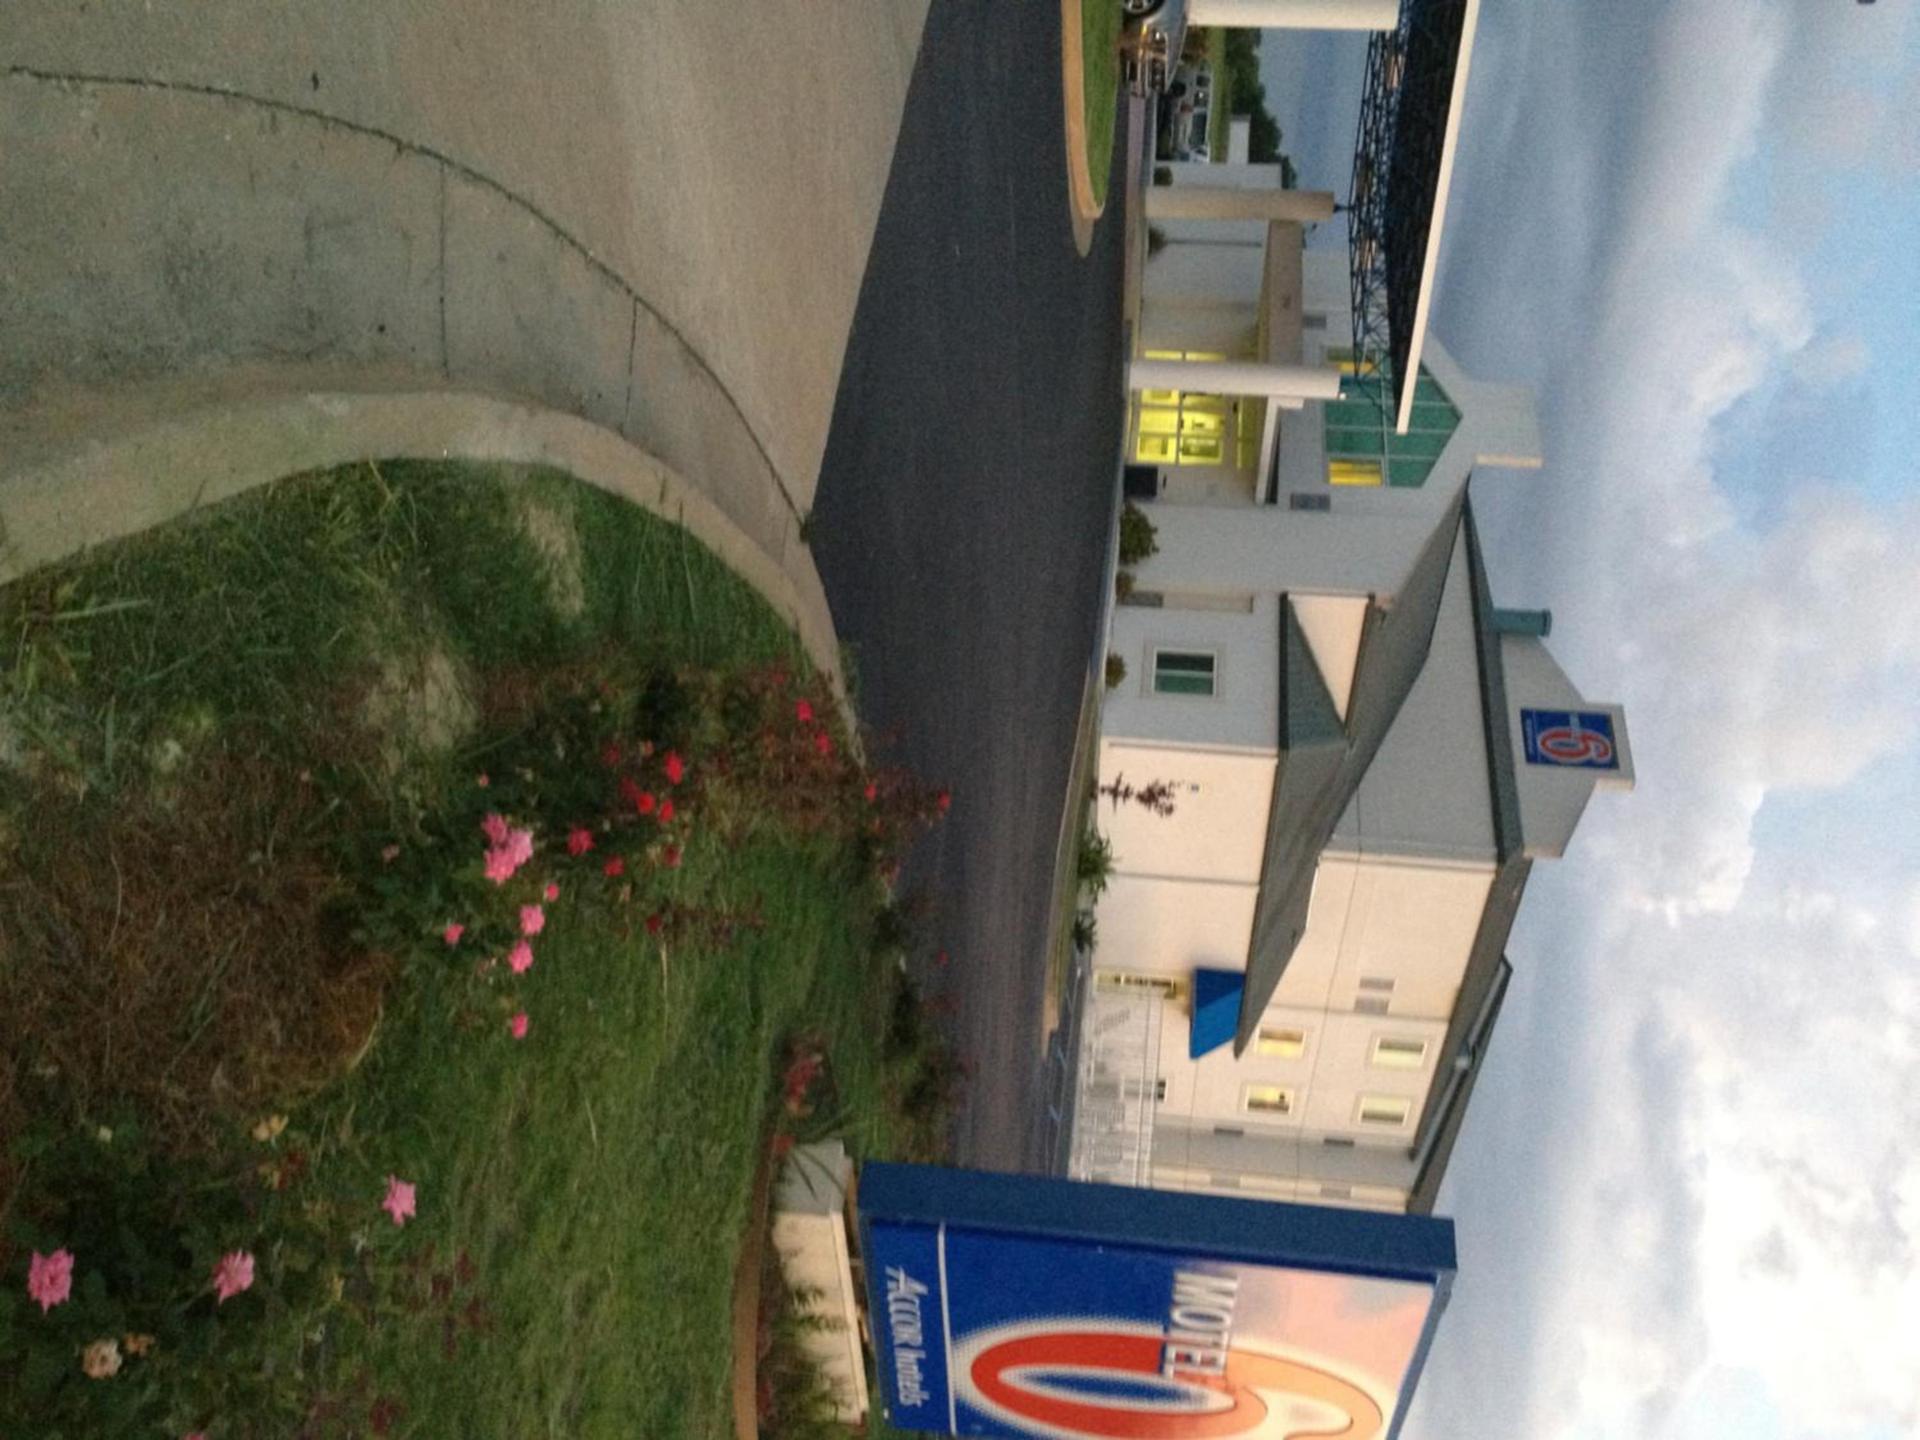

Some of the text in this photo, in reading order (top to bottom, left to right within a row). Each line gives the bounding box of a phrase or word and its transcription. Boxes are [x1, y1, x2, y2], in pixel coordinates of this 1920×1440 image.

[895, 1347, 930, 1408] hotels
[970, 1271, 1384, 1440] MOTEL 6
